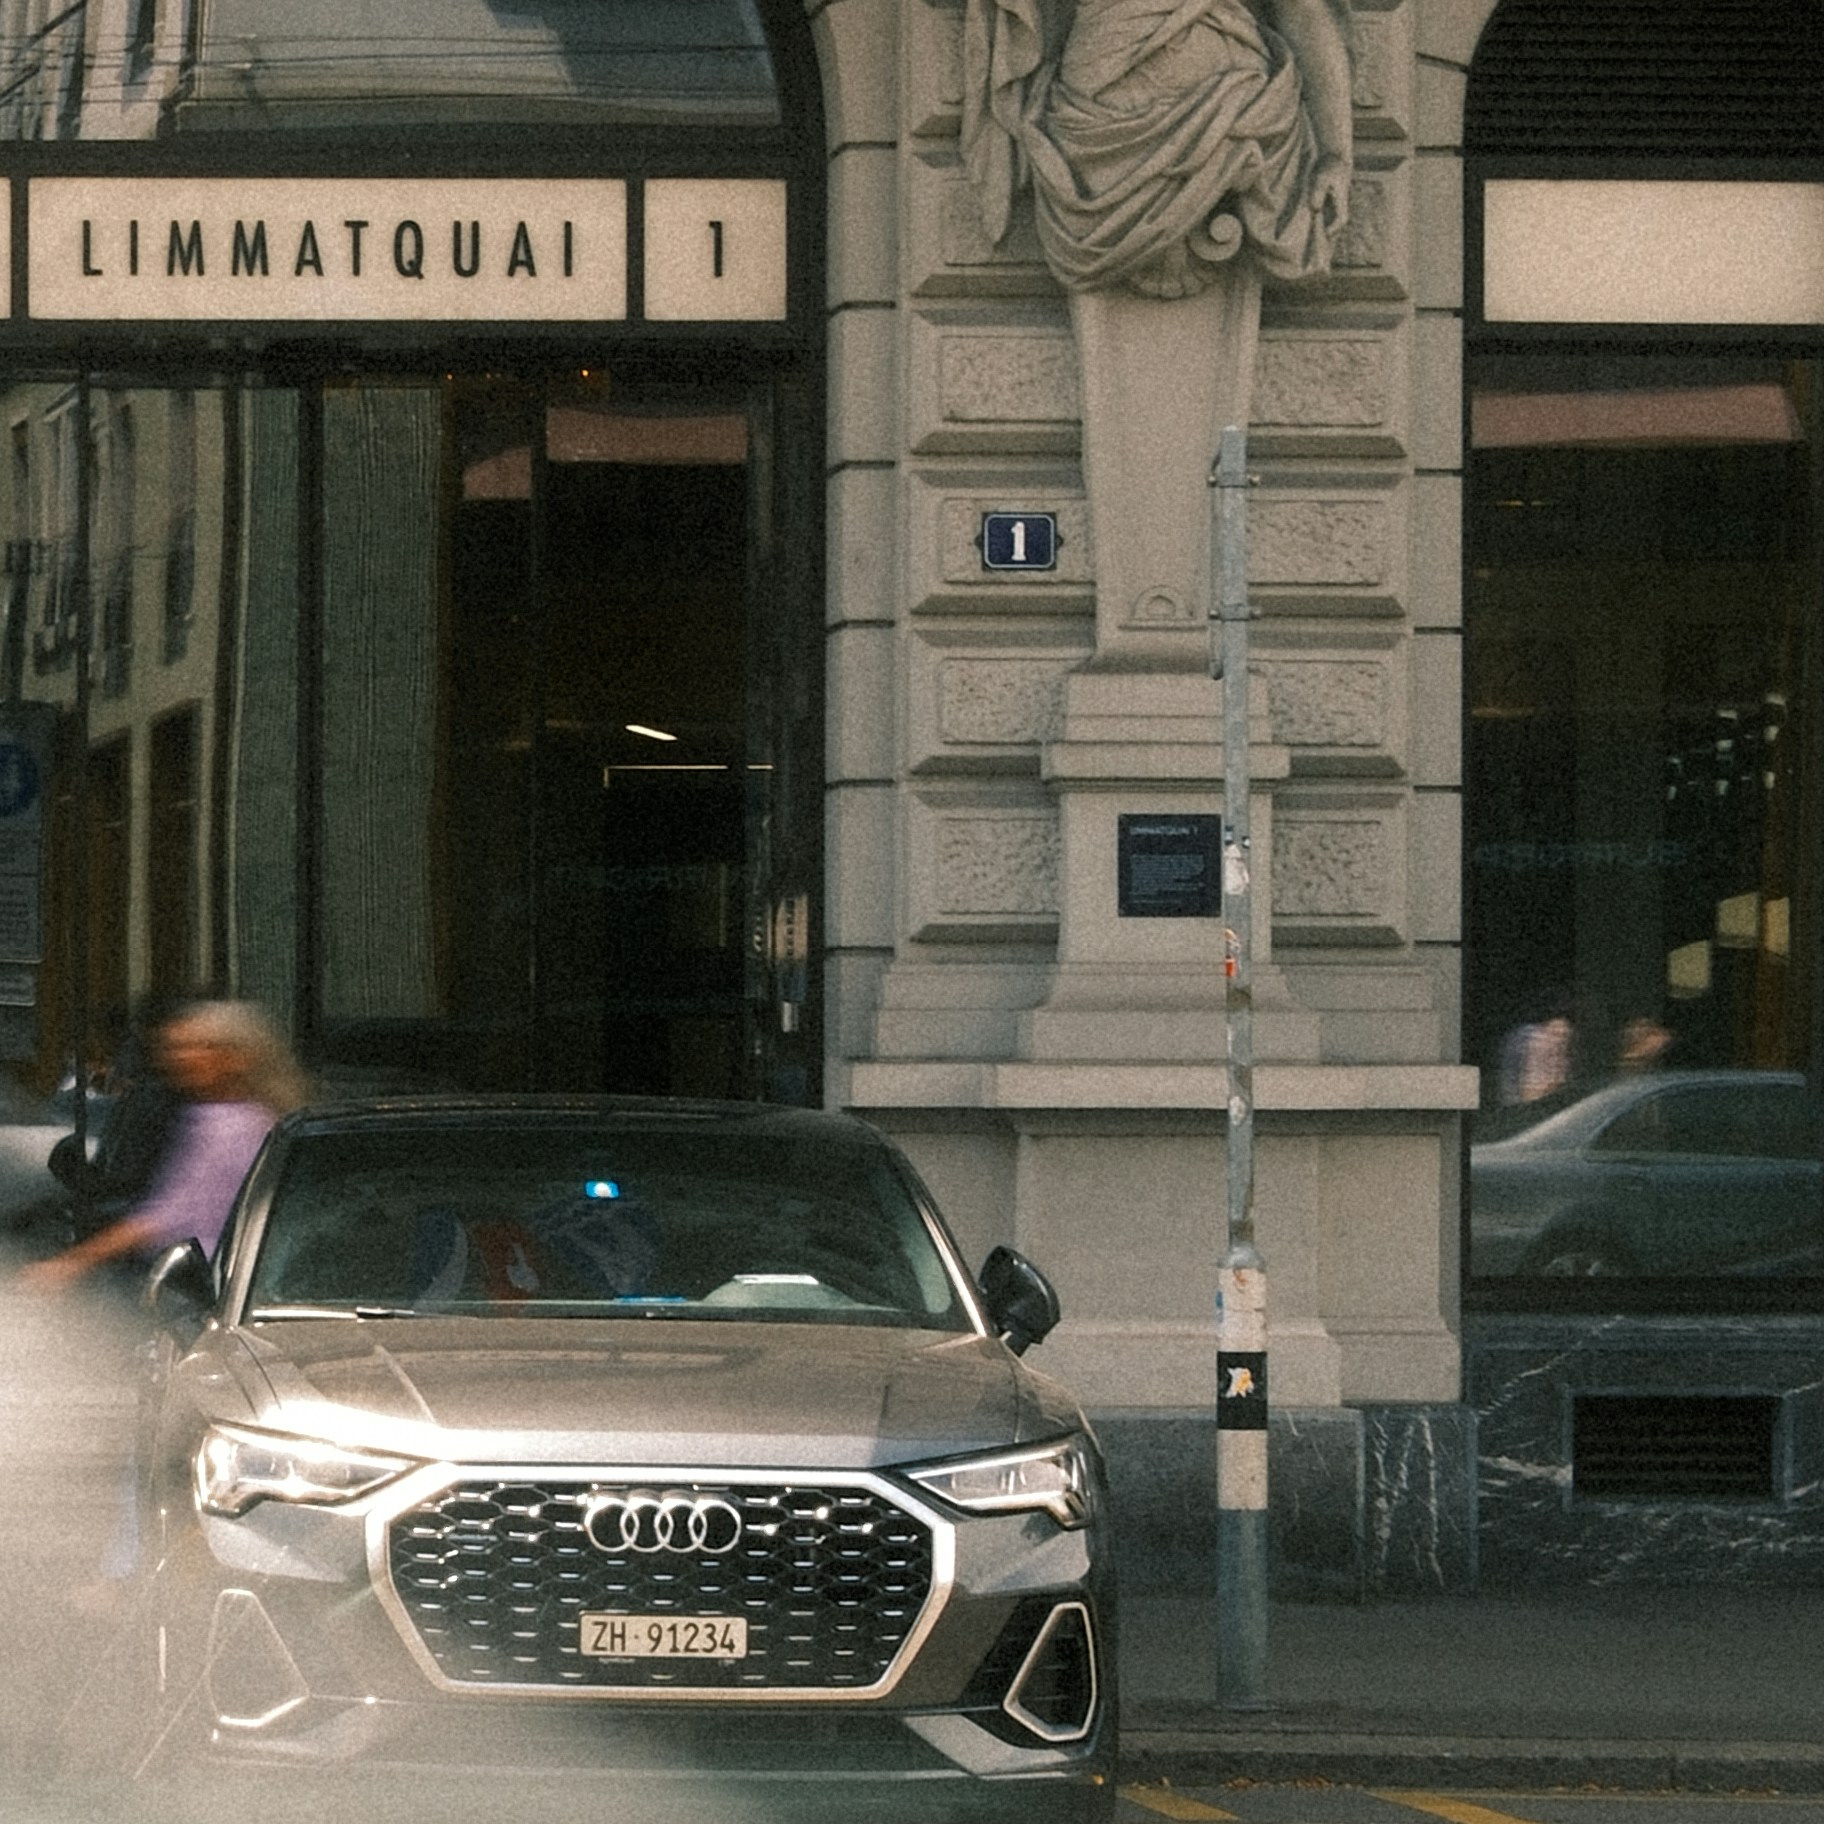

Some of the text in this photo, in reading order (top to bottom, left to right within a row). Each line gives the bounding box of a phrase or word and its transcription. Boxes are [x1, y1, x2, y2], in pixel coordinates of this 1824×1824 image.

[82, 219, 573, 279] LIMMATQUAI
[708, 220, 724, 278] 1
[1010, 521, 1027, 561] 1
